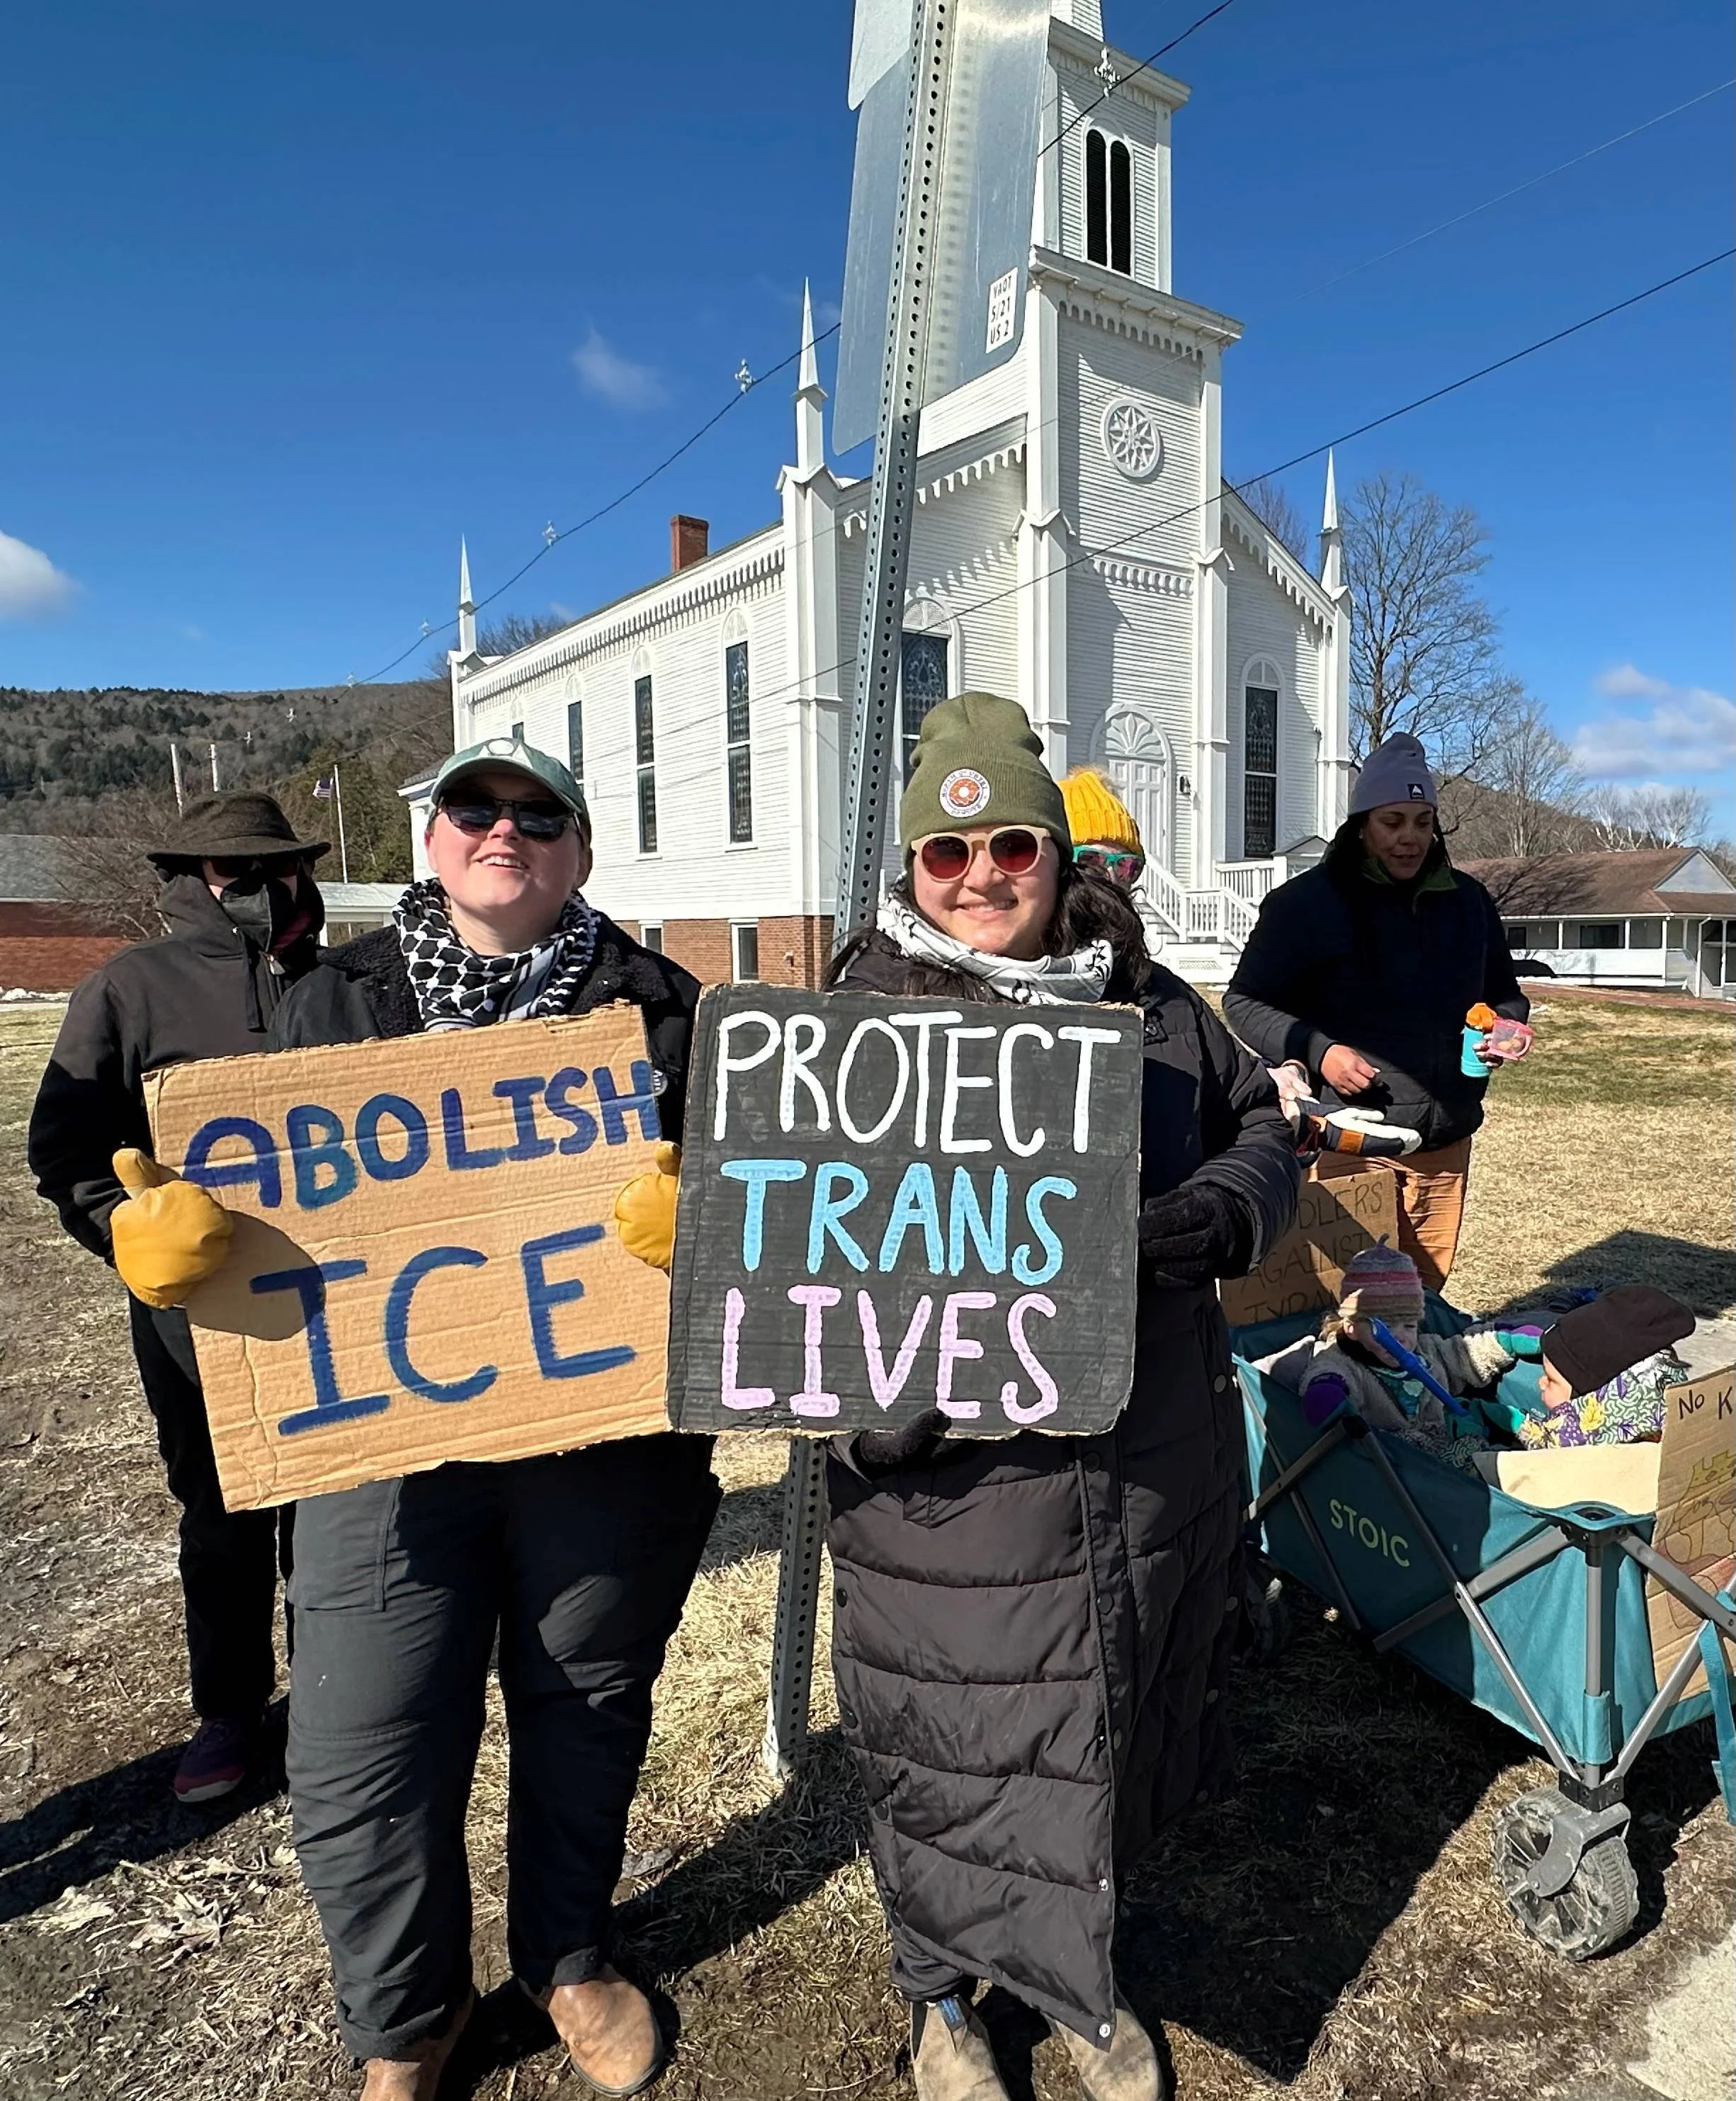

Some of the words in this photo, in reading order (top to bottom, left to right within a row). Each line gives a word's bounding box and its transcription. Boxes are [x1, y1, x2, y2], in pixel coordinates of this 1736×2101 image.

[990, 324, 1001, 344] US
[1004, 319, 1009, 336] 2
[991, 296, 1010, 322] 5/21
[993, 275, 1012, 298] VAOT
[183, 1060, 662, 1209] ABOLISH
[714, 1010, 1122, 1157] PROTECT
[720, 1159, 1077, 1286] TRANS
[249, 1224, 637, 1436] ICE
[720, 1285, 1059, 1424] LIVES
[1329, 1499, 1409, 1567] STOIC
